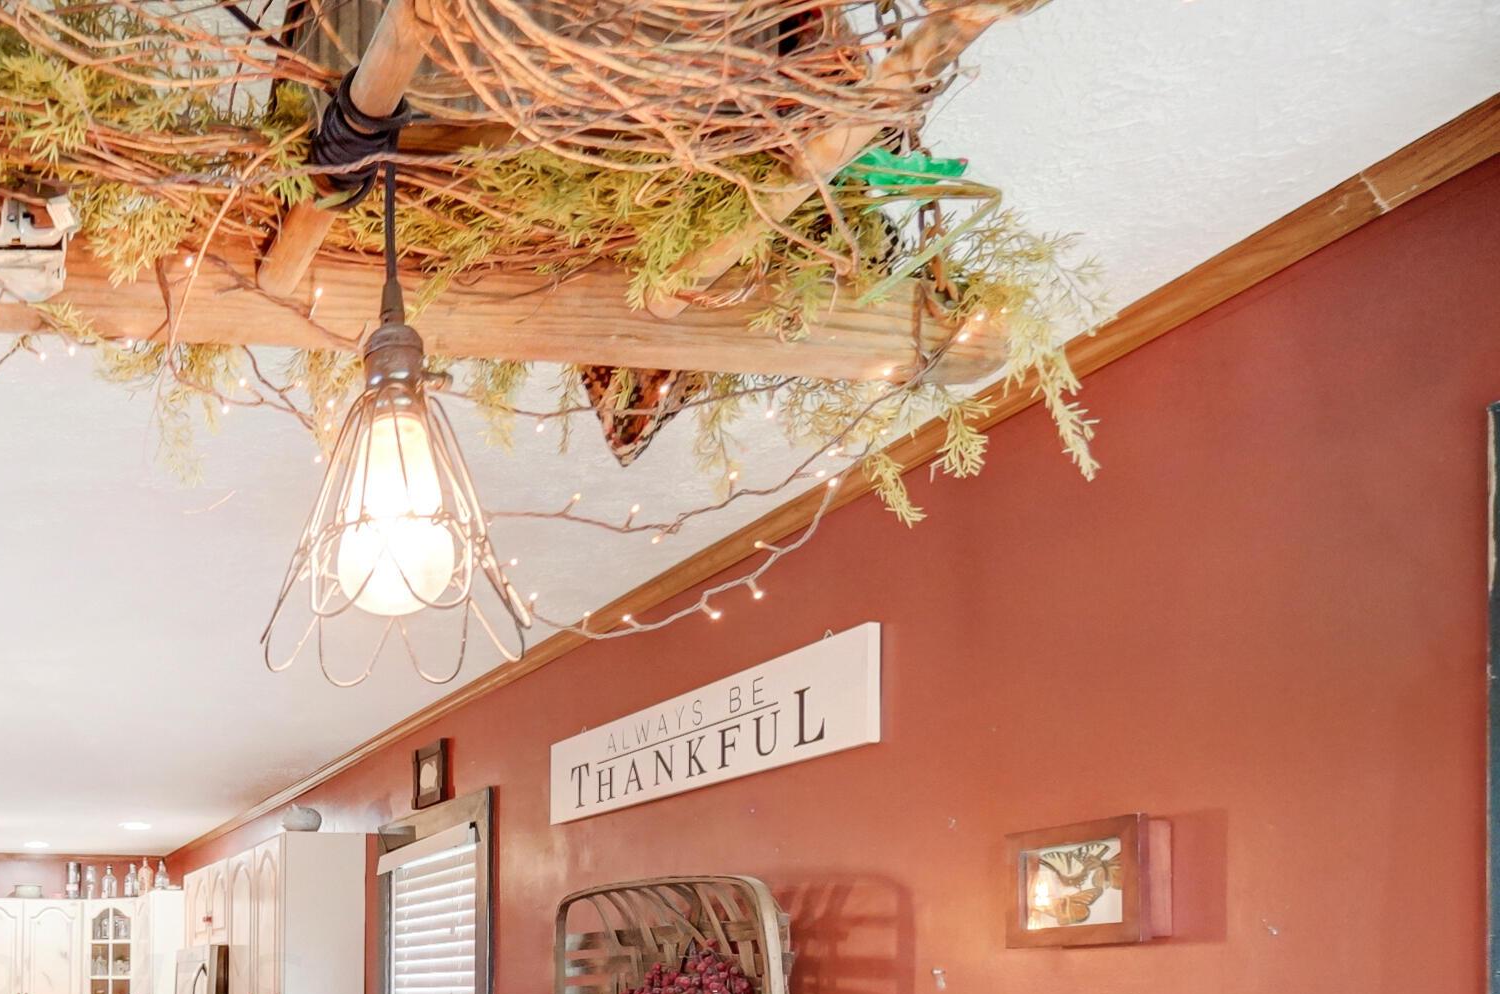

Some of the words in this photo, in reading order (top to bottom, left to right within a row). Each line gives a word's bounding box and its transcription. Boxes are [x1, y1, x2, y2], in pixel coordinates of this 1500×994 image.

[570, 685, 826, 809] THANKFUL
[605, 699, 703, 754] ALWAYS
[729, 676, 764, 714] BE
